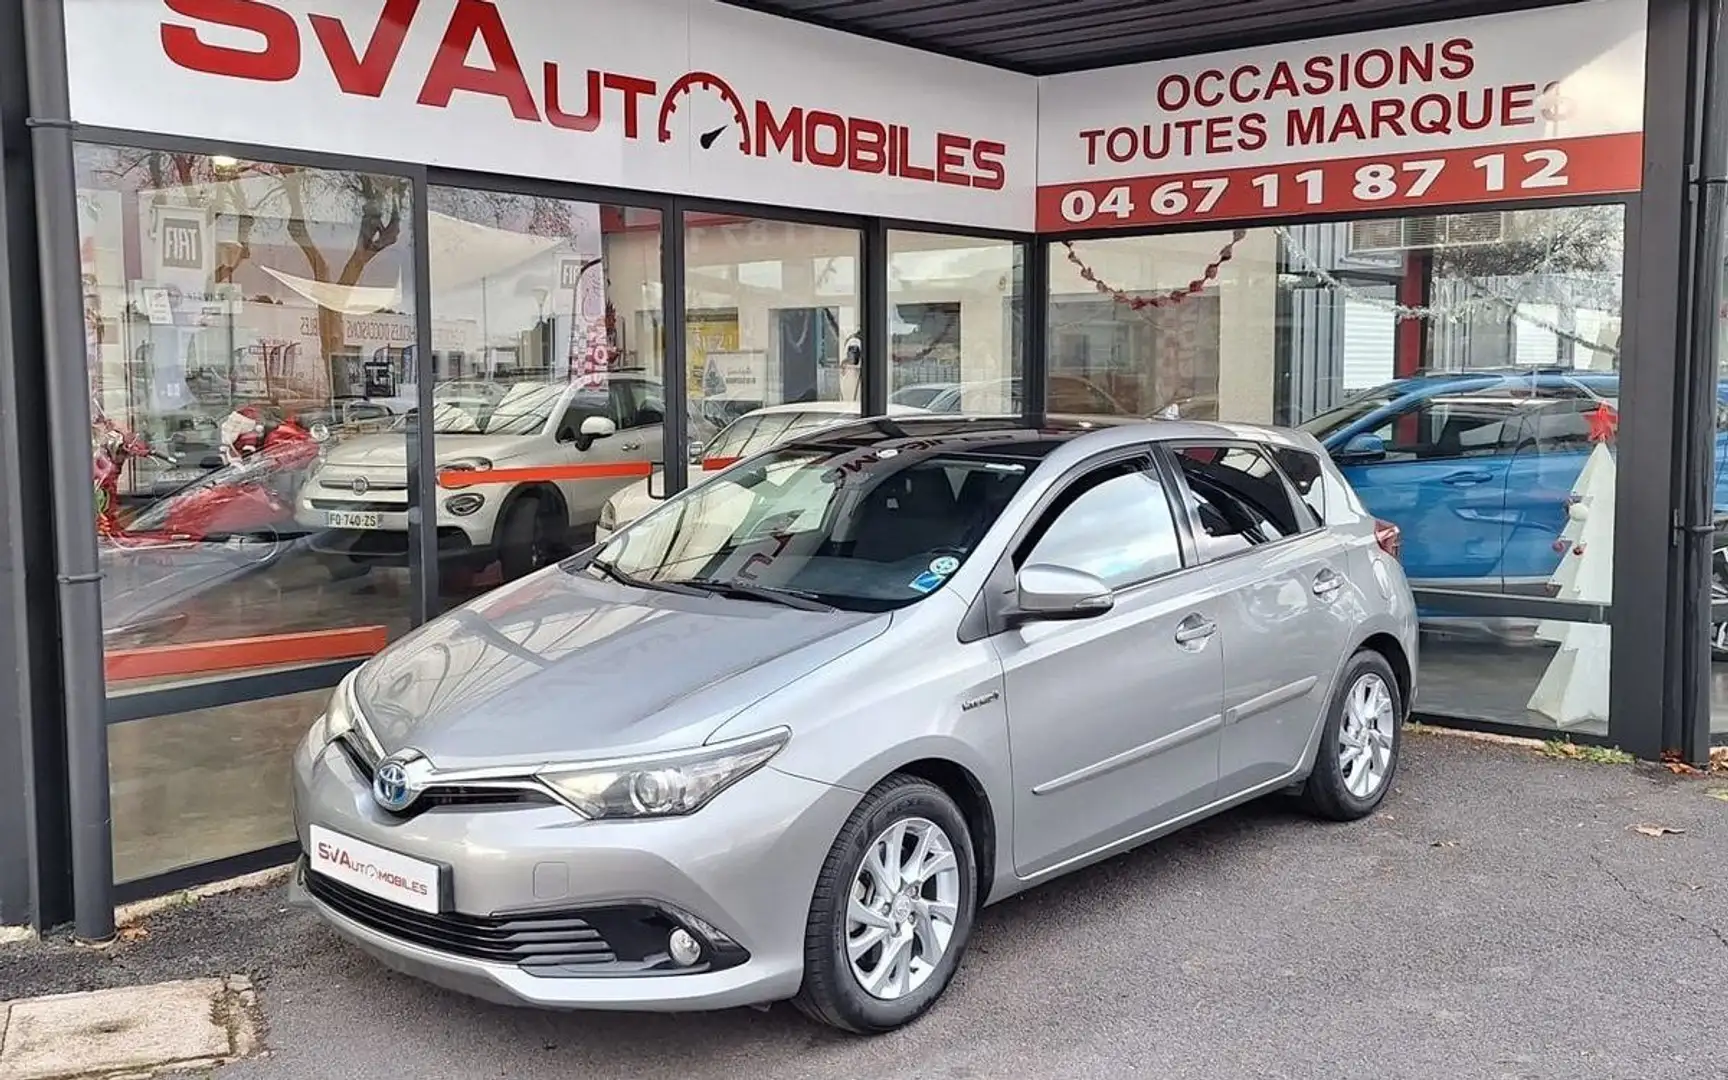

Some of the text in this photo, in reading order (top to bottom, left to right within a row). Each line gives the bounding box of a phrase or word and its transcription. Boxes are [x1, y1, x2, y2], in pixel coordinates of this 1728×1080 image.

[1156, 38, 1474, 111] OCCASIONS
[1080, 113, 1267, 165] TOUTES
[1060, 149, 1569, 222] 04 67 11 87 12
[163, 227, 198, 261] FIAT
